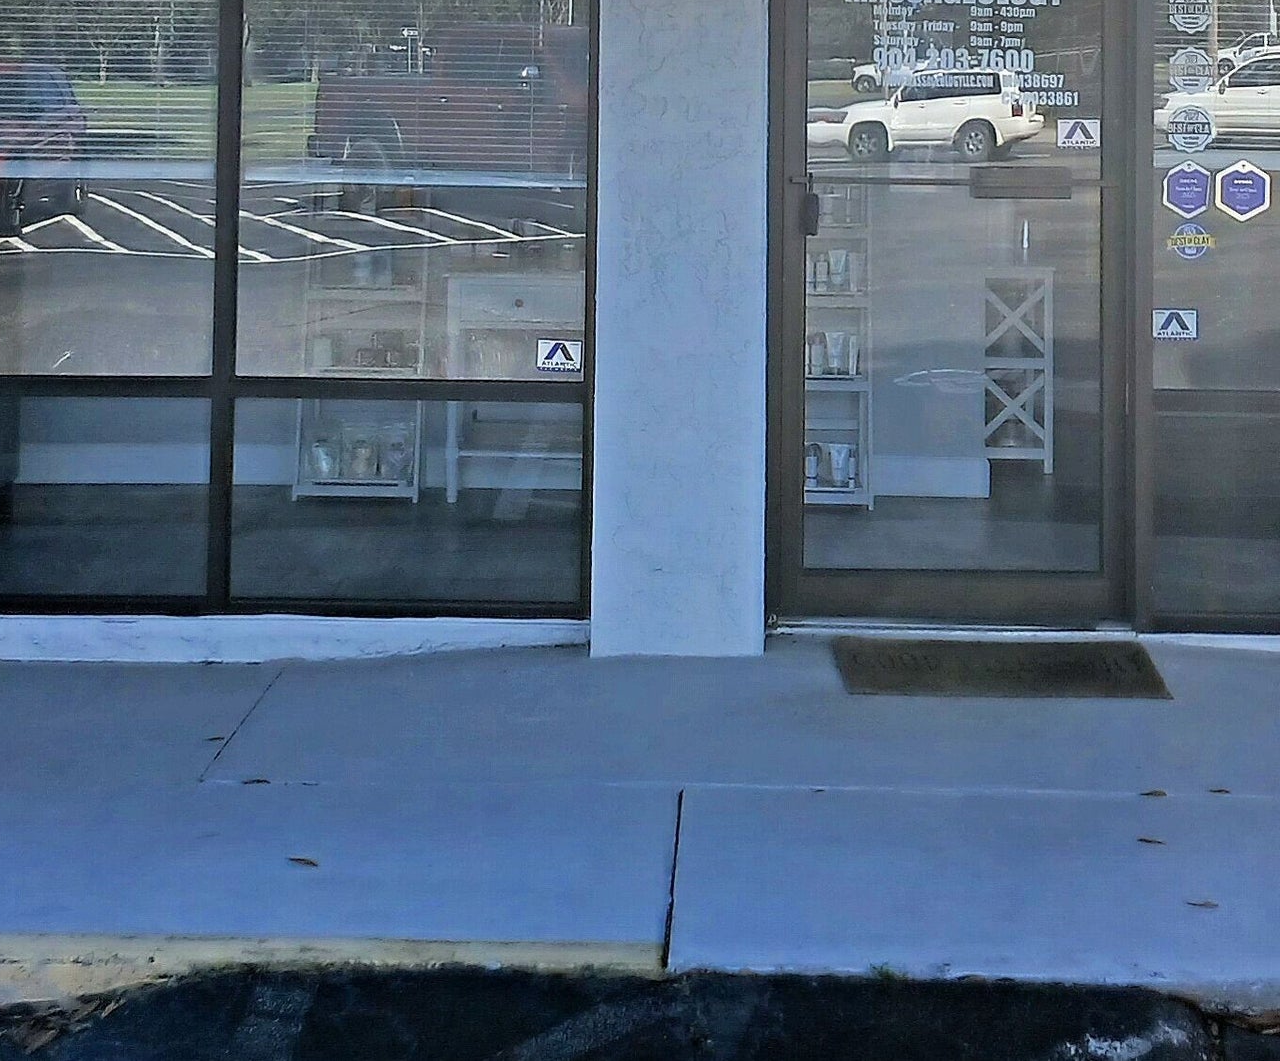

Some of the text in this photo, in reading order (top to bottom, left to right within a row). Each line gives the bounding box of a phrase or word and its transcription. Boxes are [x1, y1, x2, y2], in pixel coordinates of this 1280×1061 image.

[873, 5, 914, 17] Monday
[970, 6, 993, 17] 9am
[923, 20, 955, 32] Friday
[970, 20, 993, 32] 9am
[1000, 21, 1024, 33] 9pm
